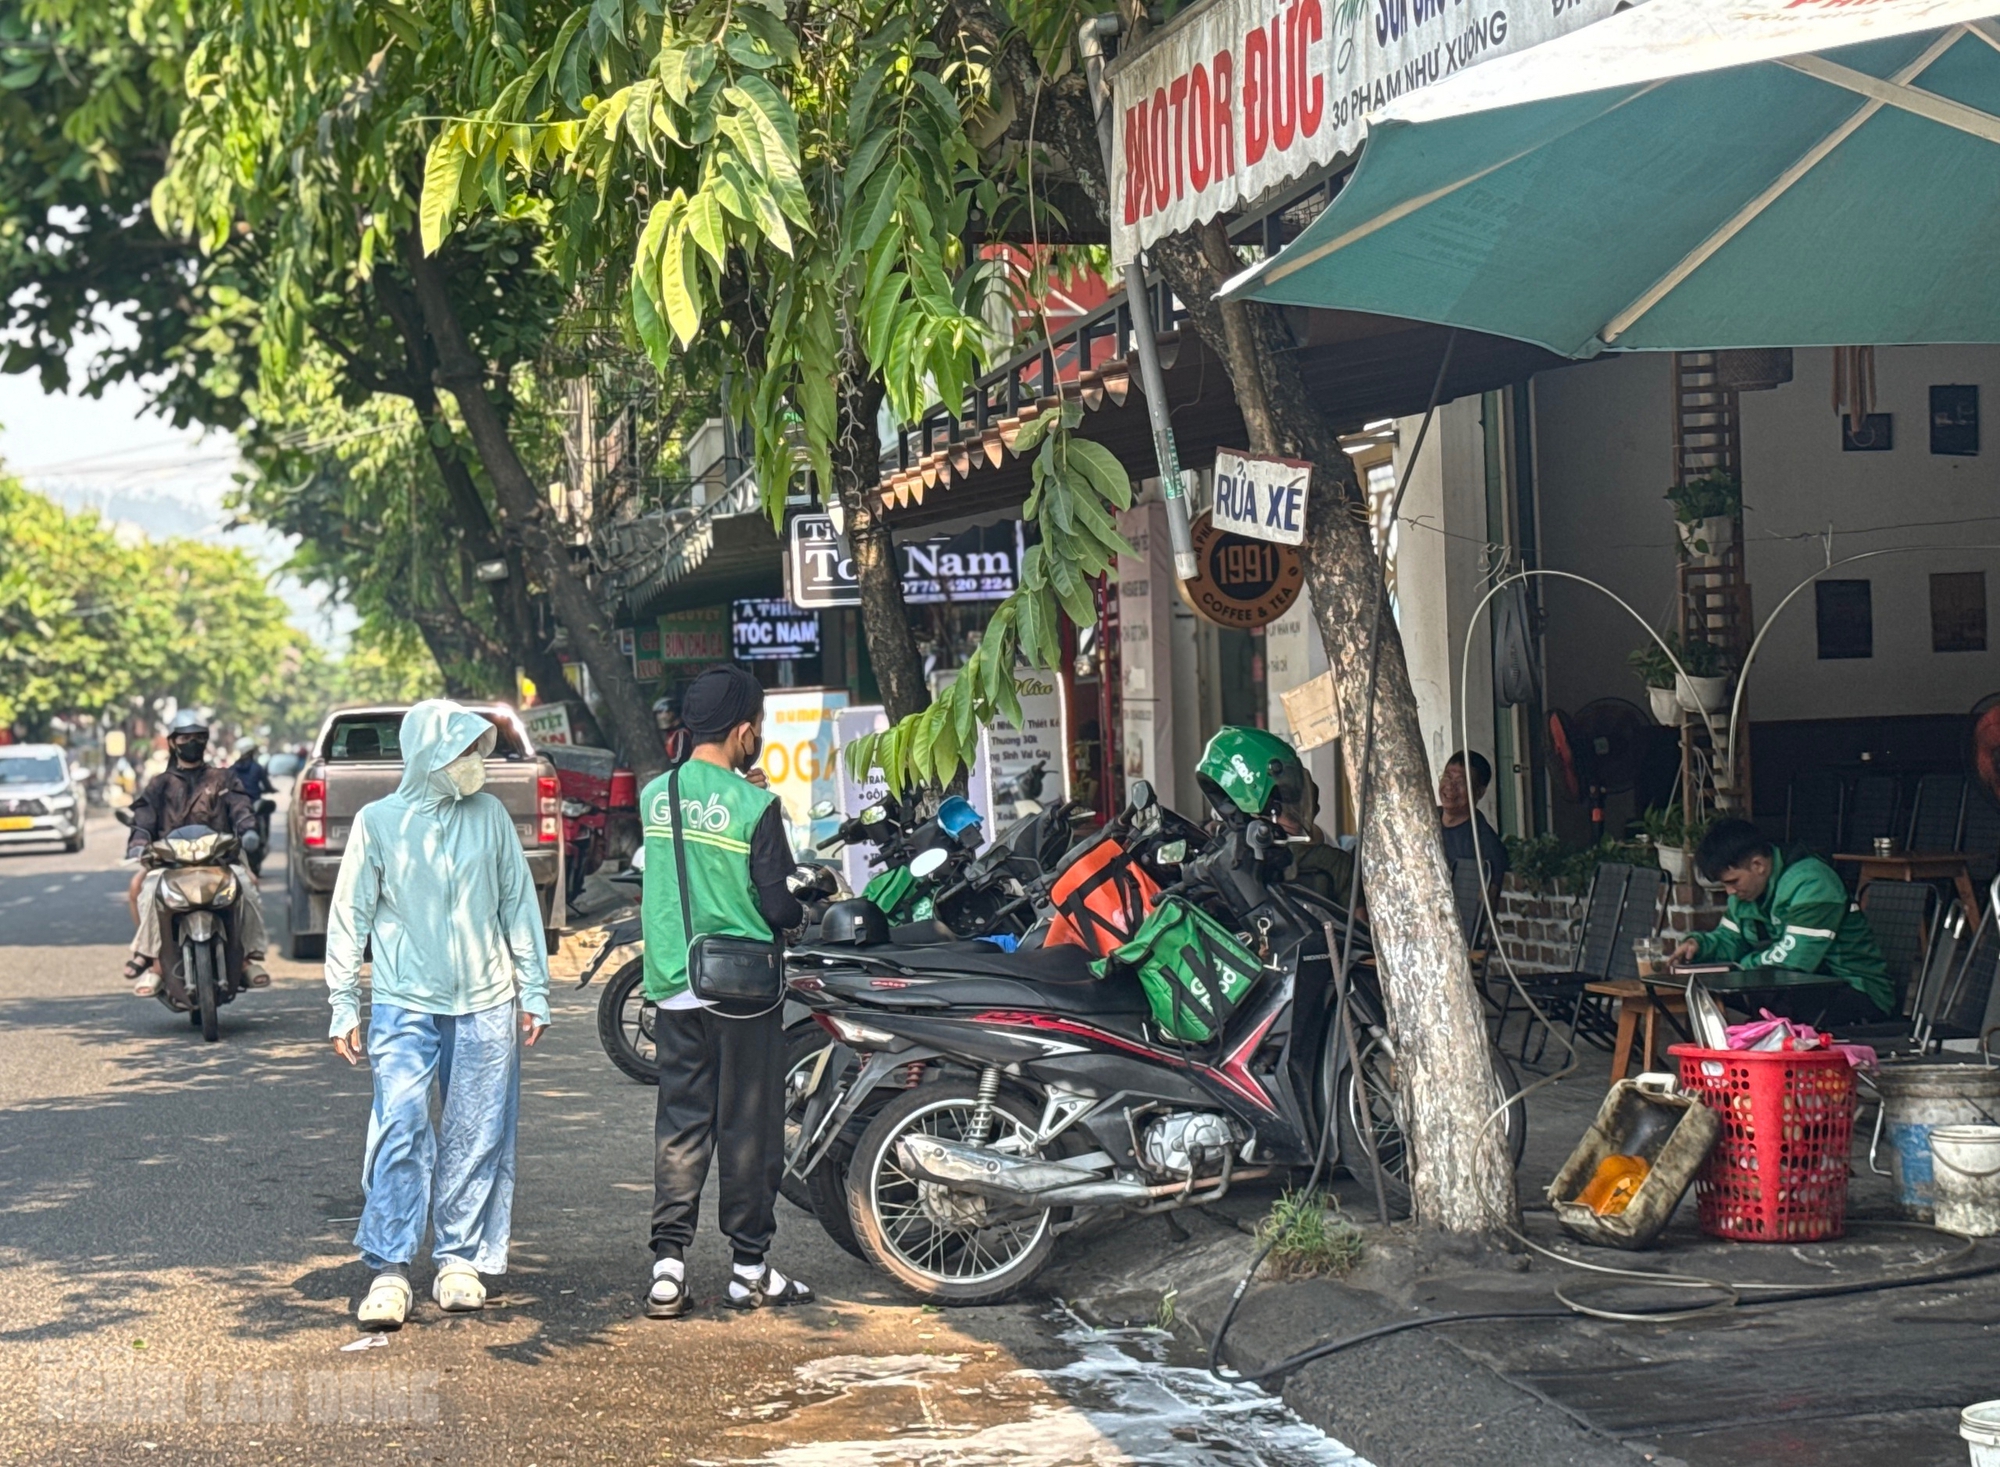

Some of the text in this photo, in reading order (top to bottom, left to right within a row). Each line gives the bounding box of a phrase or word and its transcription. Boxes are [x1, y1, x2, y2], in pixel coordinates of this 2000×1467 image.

[1332, 96, 1348, 131] 30
[1124, 49, 1235, 225] MOTOR
[902, 544, 1013, 578] Nam
[1216, 544, 1275, 585] 1991
[1202, 586, 1293, 621] COFFEE & TEA
[737, 617, 816, 645] TÓC NAM
[651, 791, 731, 833] Grab
